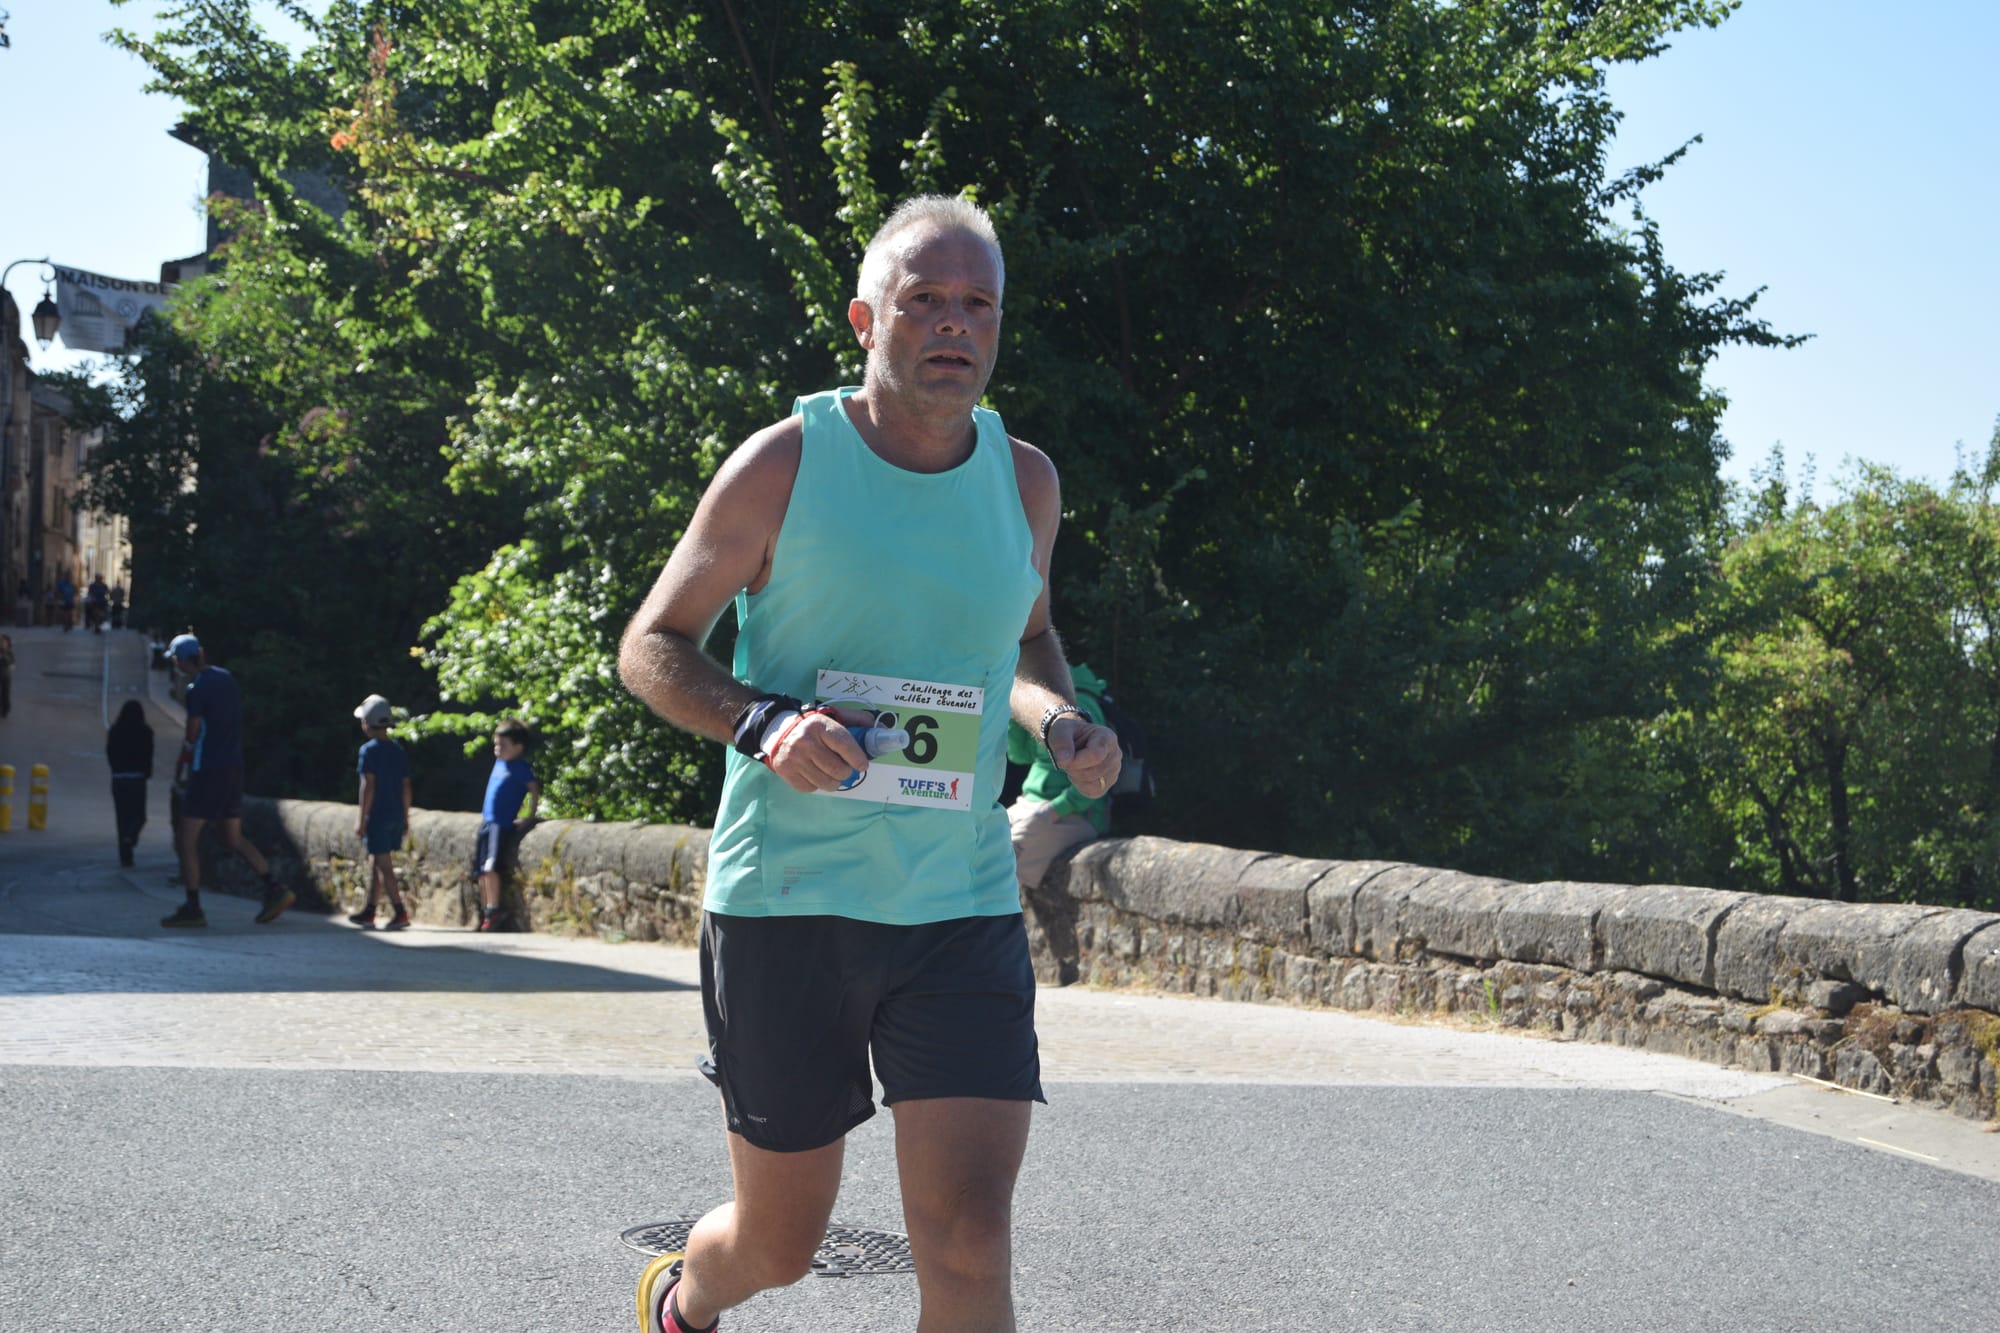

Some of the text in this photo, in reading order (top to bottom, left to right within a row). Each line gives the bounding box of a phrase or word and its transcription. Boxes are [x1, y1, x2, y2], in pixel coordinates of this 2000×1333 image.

[60, 268, 138, 292] MAISON
[901, 682, 973, 699] Challenge des
[894, 694, 977, 709] vallées cévenoles
[898, 778, 946, 791] TUFF'S
[901, 788, 949, 800] Aventure
